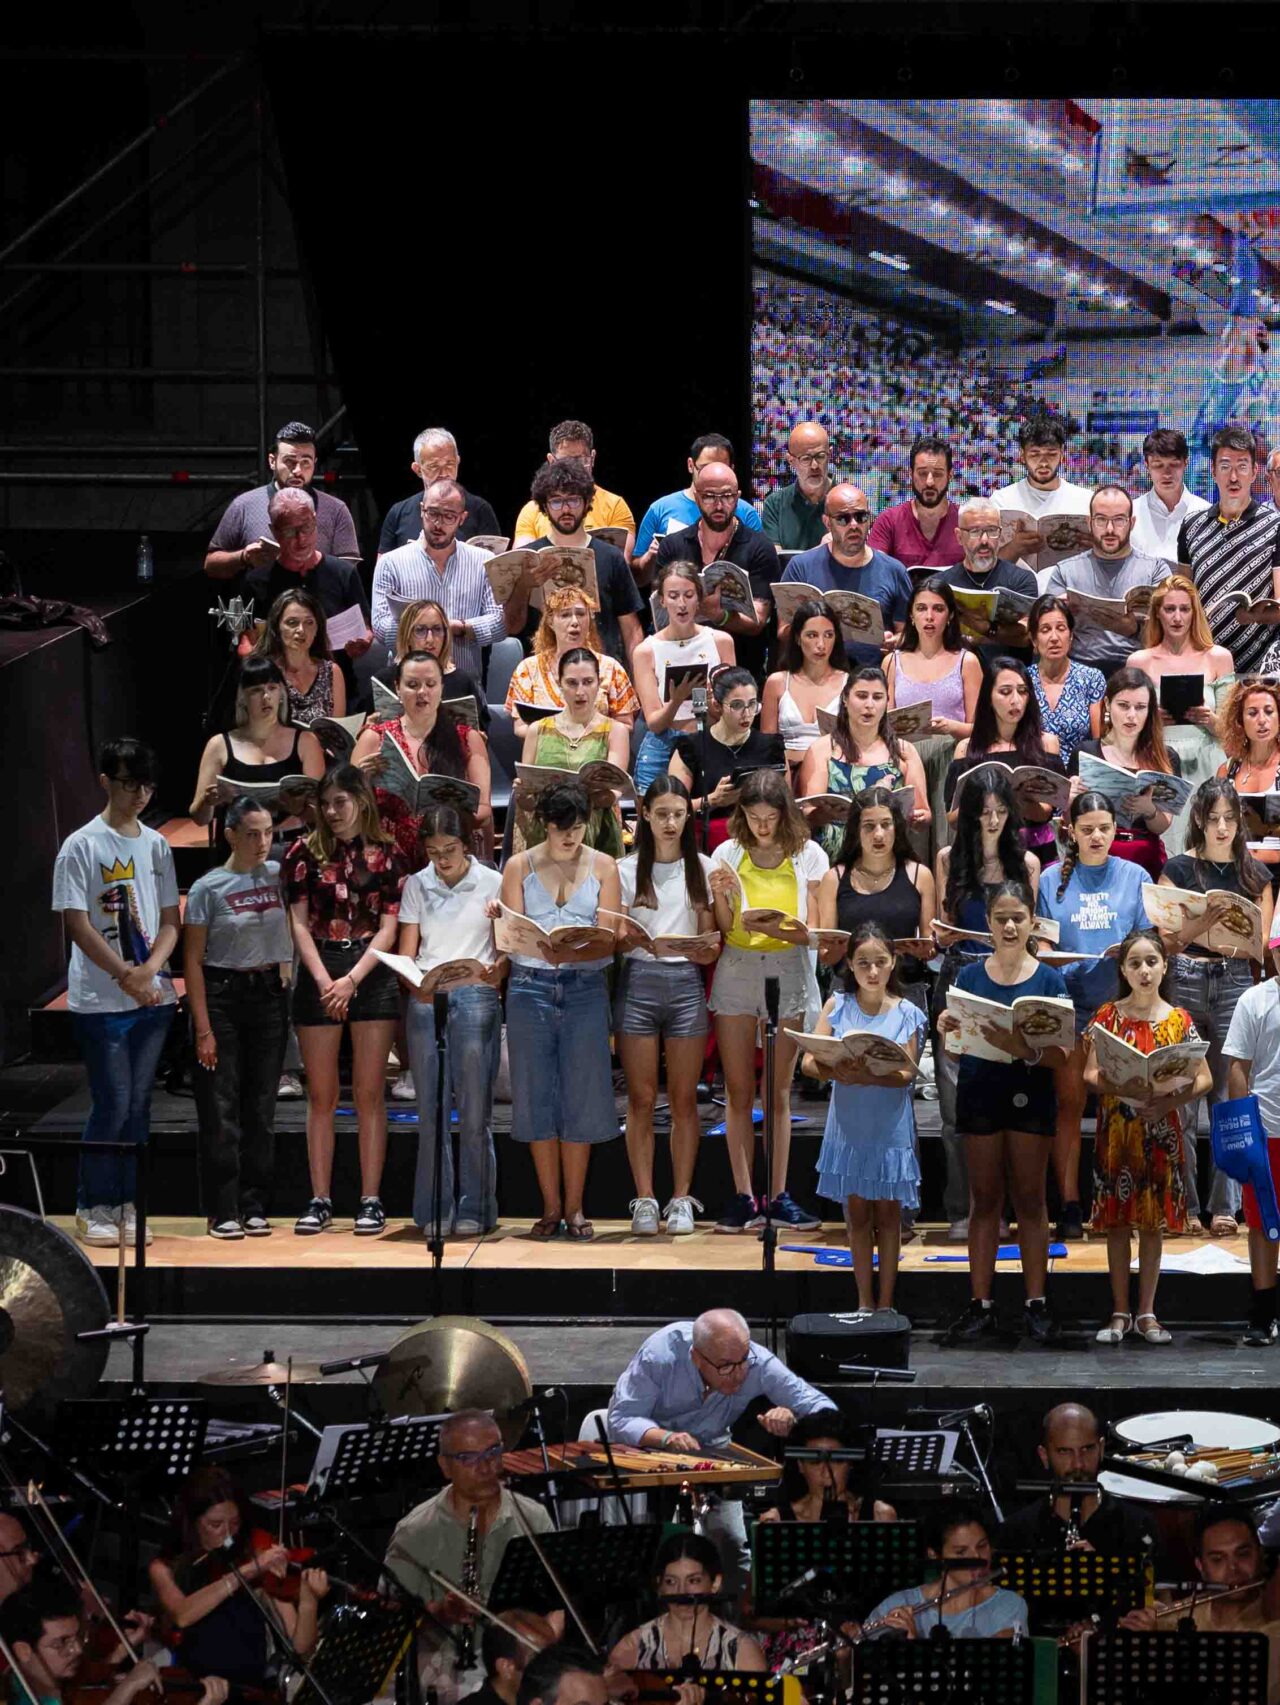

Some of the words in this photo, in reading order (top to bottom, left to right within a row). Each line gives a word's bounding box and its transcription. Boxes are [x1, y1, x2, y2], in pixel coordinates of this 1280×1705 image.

[1225, 566, 1251, 591] LEGENDARY
[1071, 913, 1088, 923] AND
[1079, 920, 1112, 930] ALWAYS.
